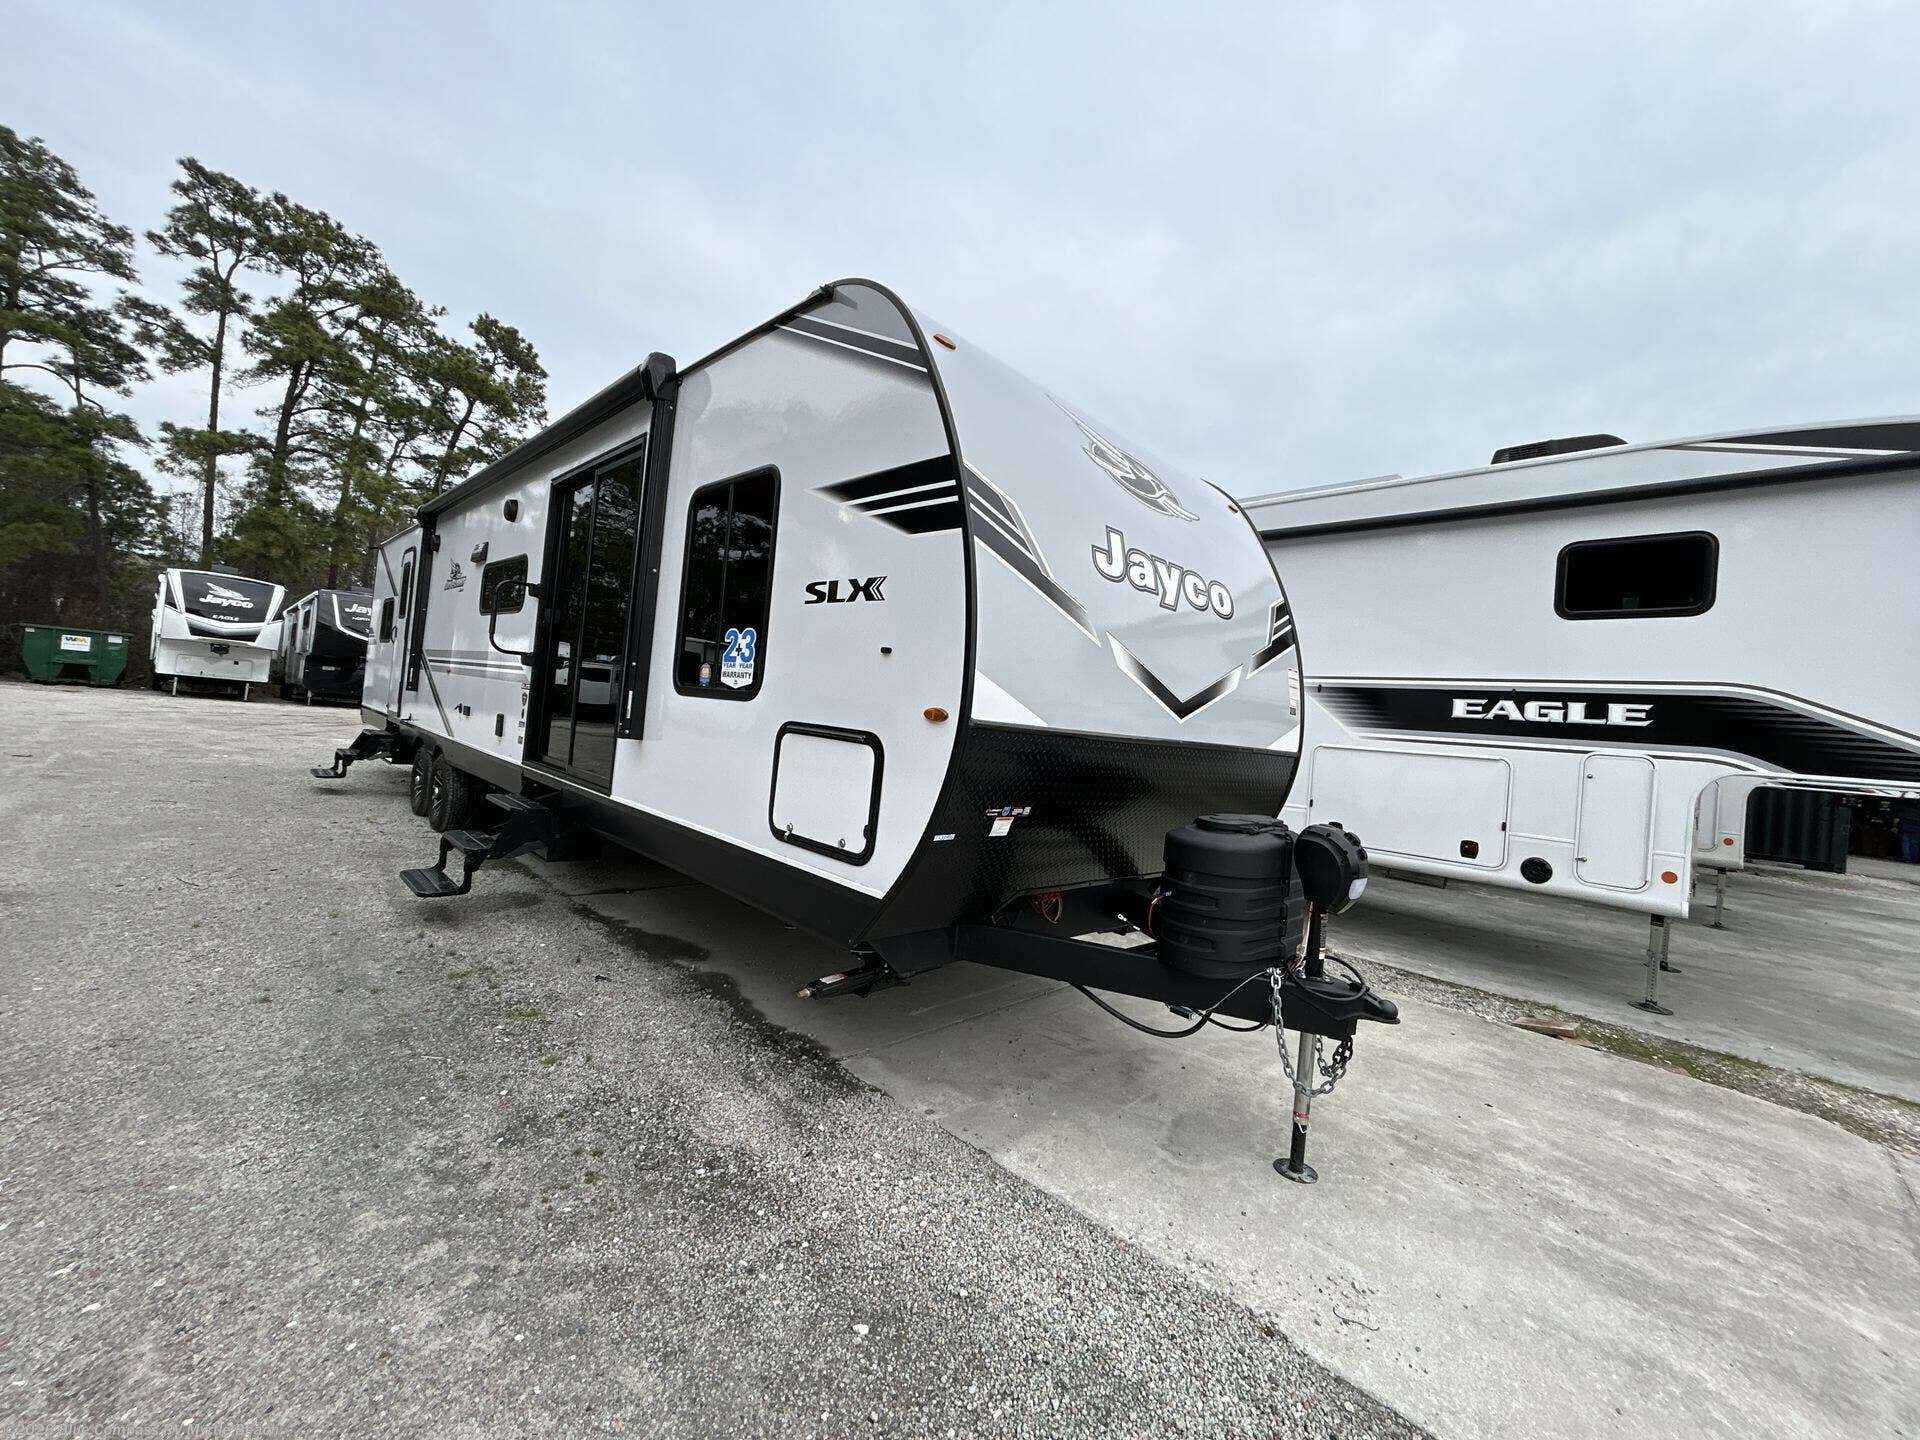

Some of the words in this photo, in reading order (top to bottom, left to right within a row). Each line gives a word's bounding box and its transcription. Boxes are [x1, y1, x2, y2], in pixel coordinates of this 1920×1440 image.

[1091, 525, 1235, 621] Jayco
[199, 594, 254, 609] Jayco
[804, 576, 887, 605] SLX
[212, 614, 240, 622] EAGLE
[722, 671, 752, 679] WARRANTY
[1451, 698, 1654, 727] EAGLE
